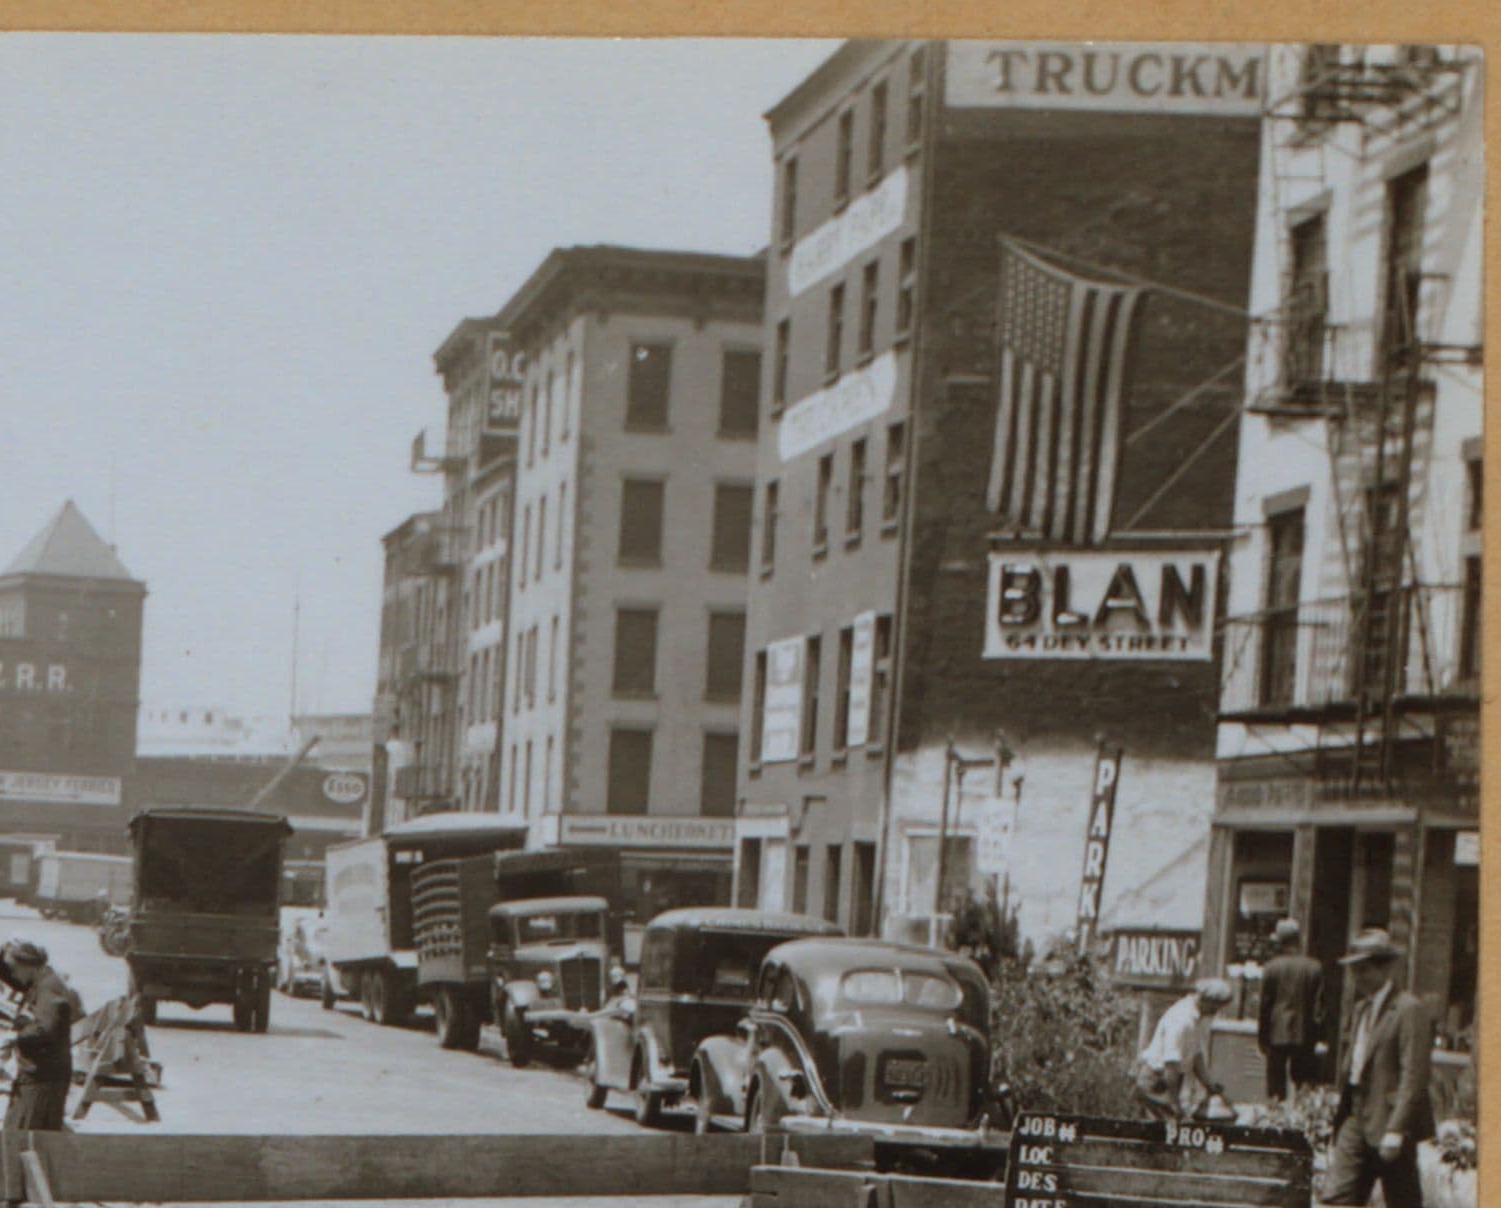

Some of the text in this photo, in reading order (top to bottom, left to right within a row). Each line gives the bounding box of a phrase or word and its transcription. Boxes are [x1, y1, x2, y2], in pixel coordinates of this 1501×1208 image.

[986, 49, 1263, 99] TRUCKM
[999, 561, 1205, 631] BLAN
[1006, 635, 1190, 652] 64 DEY STREET
[1114, 935, 1196, 977] PARKING
[1019, 1144, 1054, 1165] LOC
[1017, 1170, 1058, 1193] DES
